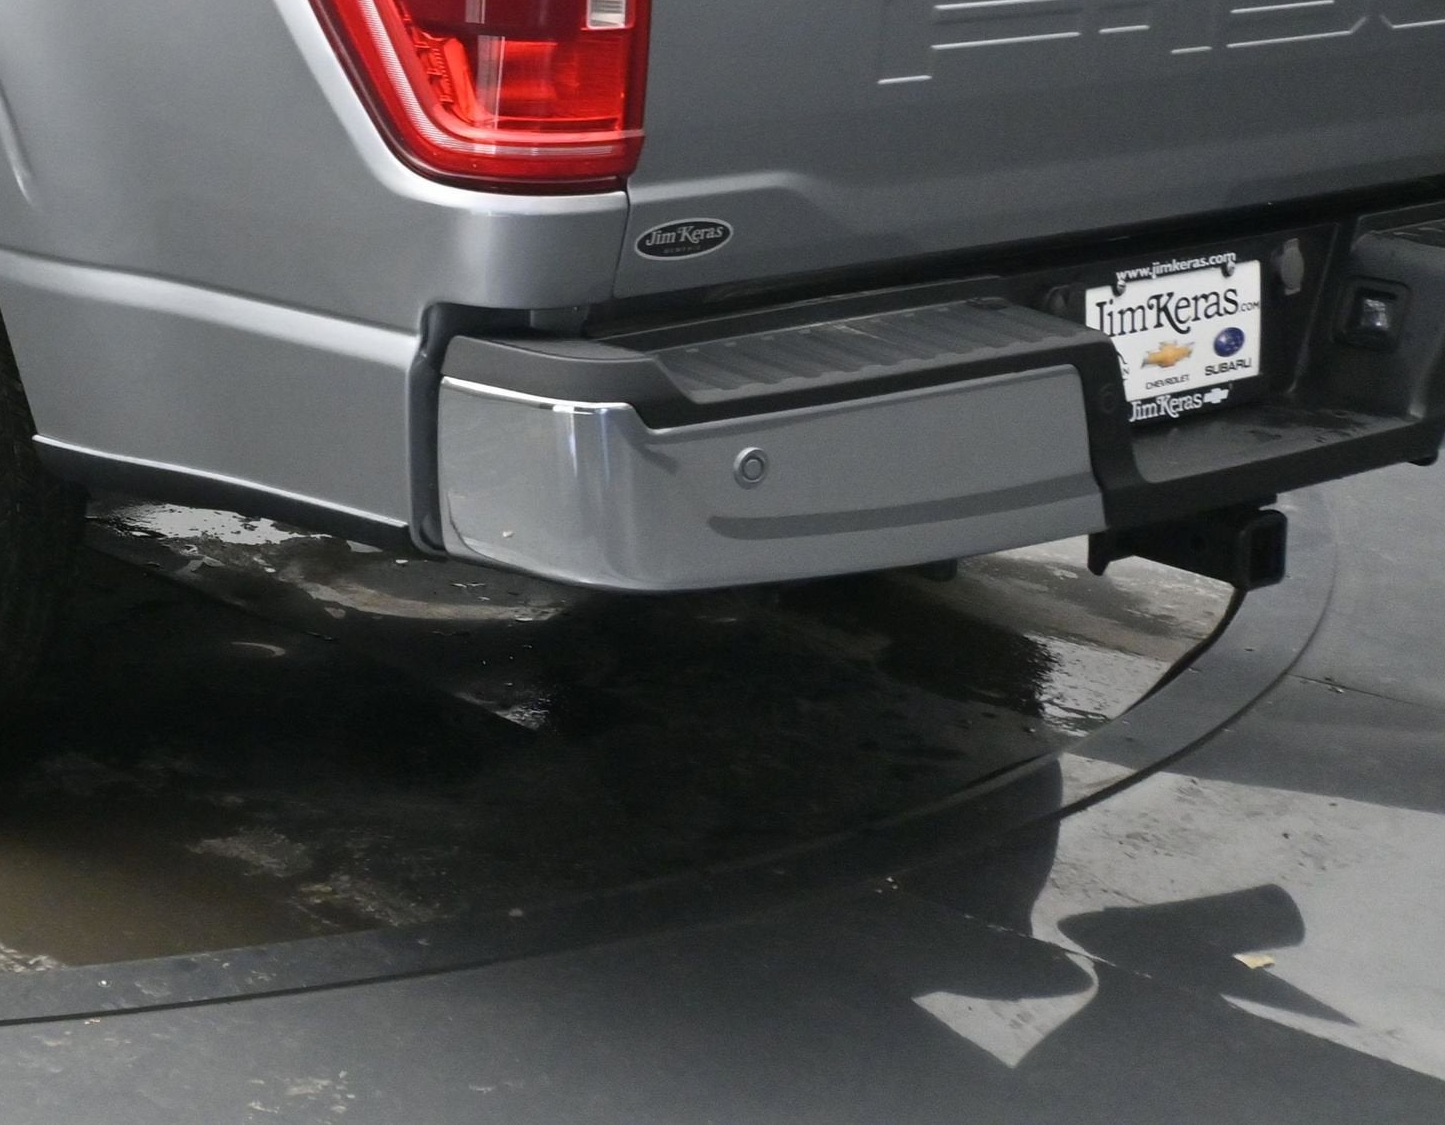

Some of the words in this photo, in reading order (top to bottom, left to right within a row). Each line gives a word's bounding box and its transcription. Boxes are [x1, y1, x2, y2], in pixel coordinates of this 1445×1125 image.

[1115, 252, 1237, 280] www.jimkeras.com
[1204, 357, 1252, 376] SUBARU
[1145, 374, 1190, 390] CHEVROLET
